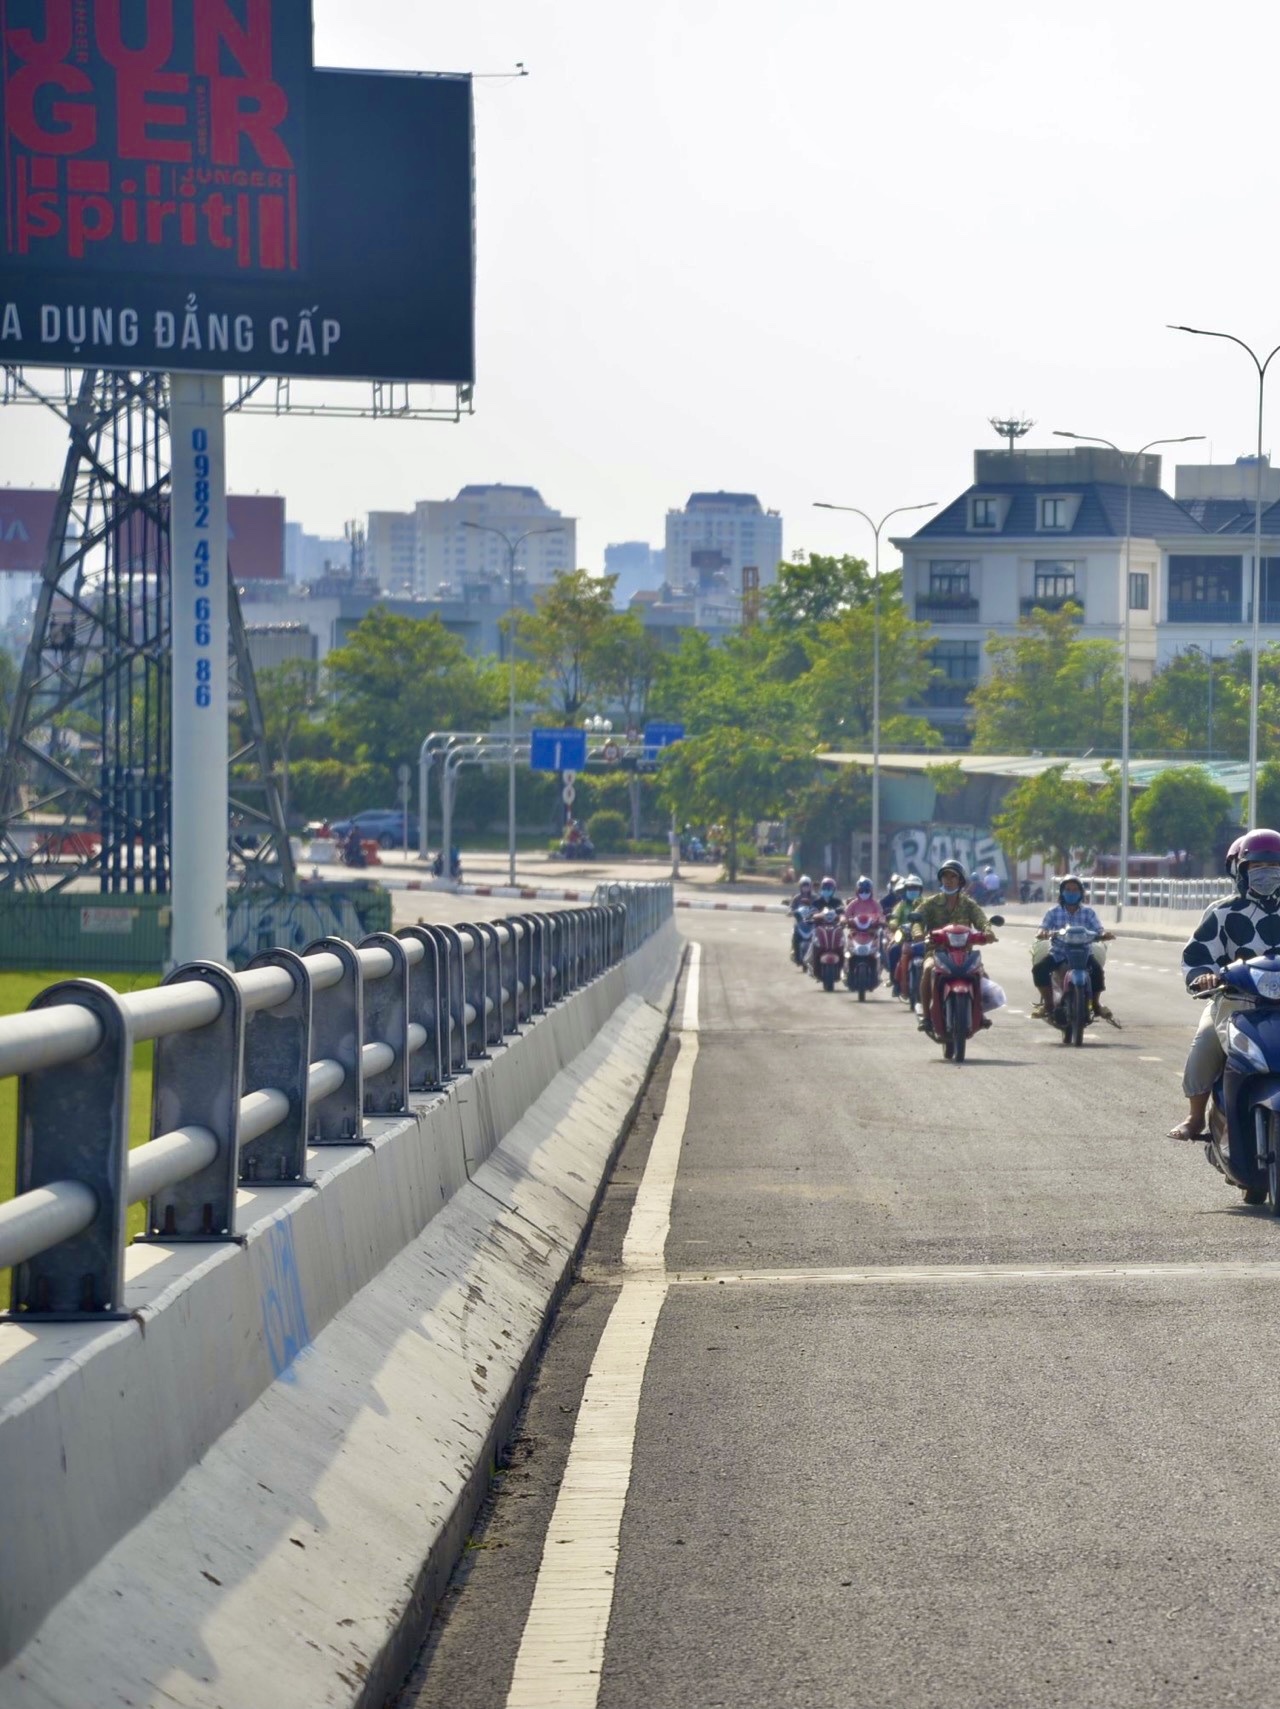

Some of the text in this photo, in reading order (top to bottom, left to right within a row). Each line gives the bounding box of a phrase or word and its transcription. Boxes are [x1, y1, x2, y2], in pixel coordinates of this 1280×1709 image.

[3, 62, 294, 169] GER
[18, 176, 234, 259] spirit
[182, 167, 284, 188] JUNGER
[2, 292, 342, 356] A DỤNG ĐẲNG CẤP
[191, 427, 211, 708] 0982 45 66 86
